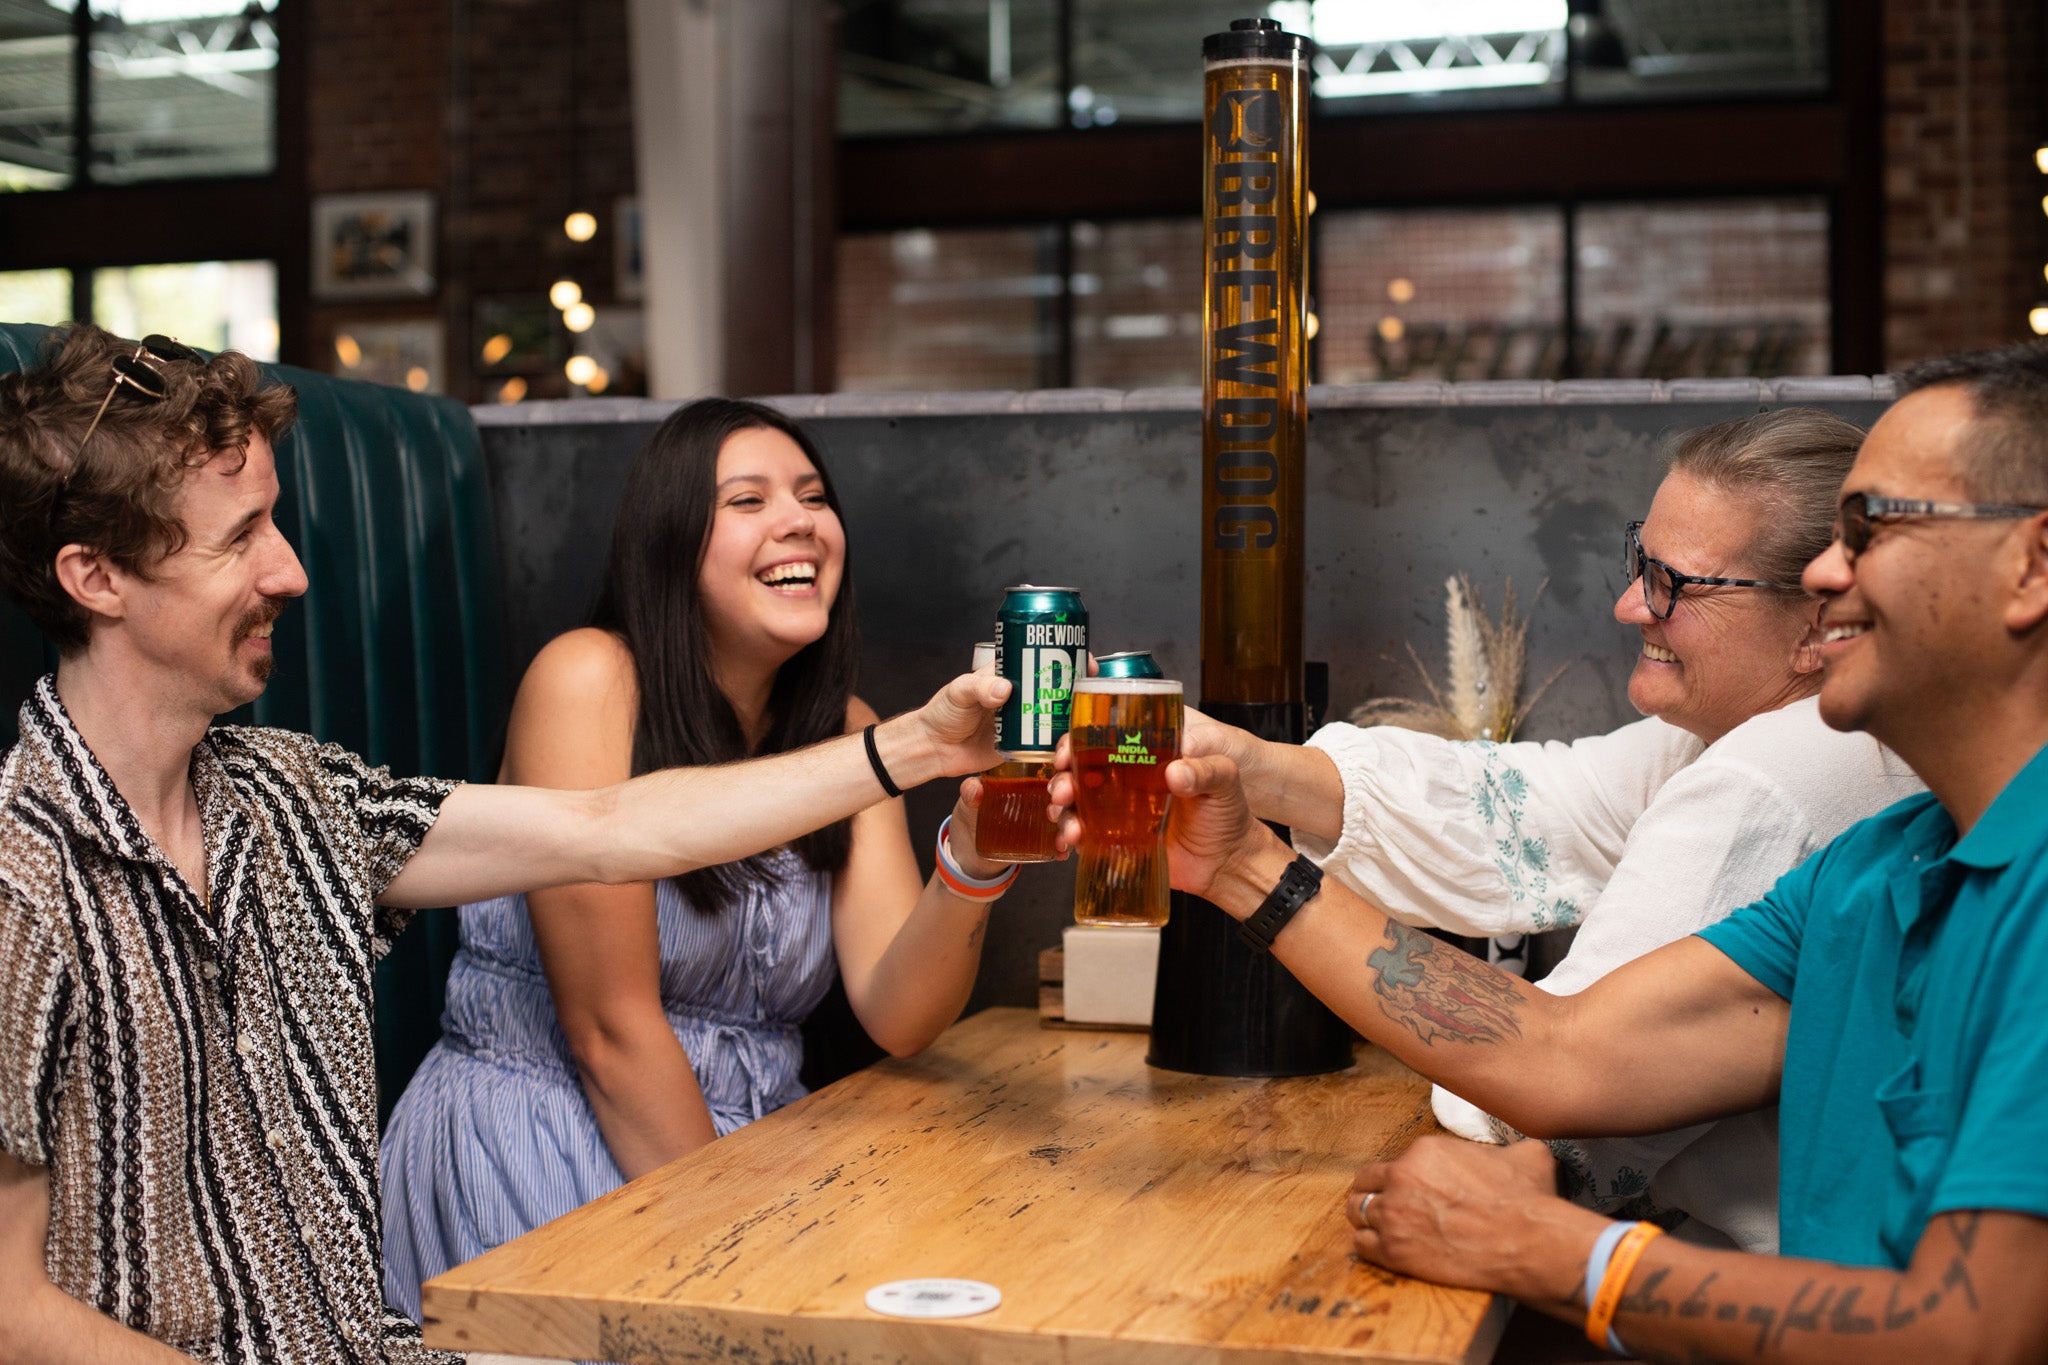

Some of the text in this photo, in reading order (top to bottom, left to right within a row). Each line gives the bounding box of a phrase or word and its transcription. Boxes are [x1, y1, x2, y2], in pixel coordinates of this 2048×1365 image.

[1214, 162, 1278, 551] BREWDOG
[1026, 624, 1086, 646] BREWDOG
[1037, 688, 1072, 700] INDI
[1022, 703, 1063, 715] PALE
[1118, 745, 1149, 755] INDIA
[1108, 754, 1157, 765] PALE ALE
